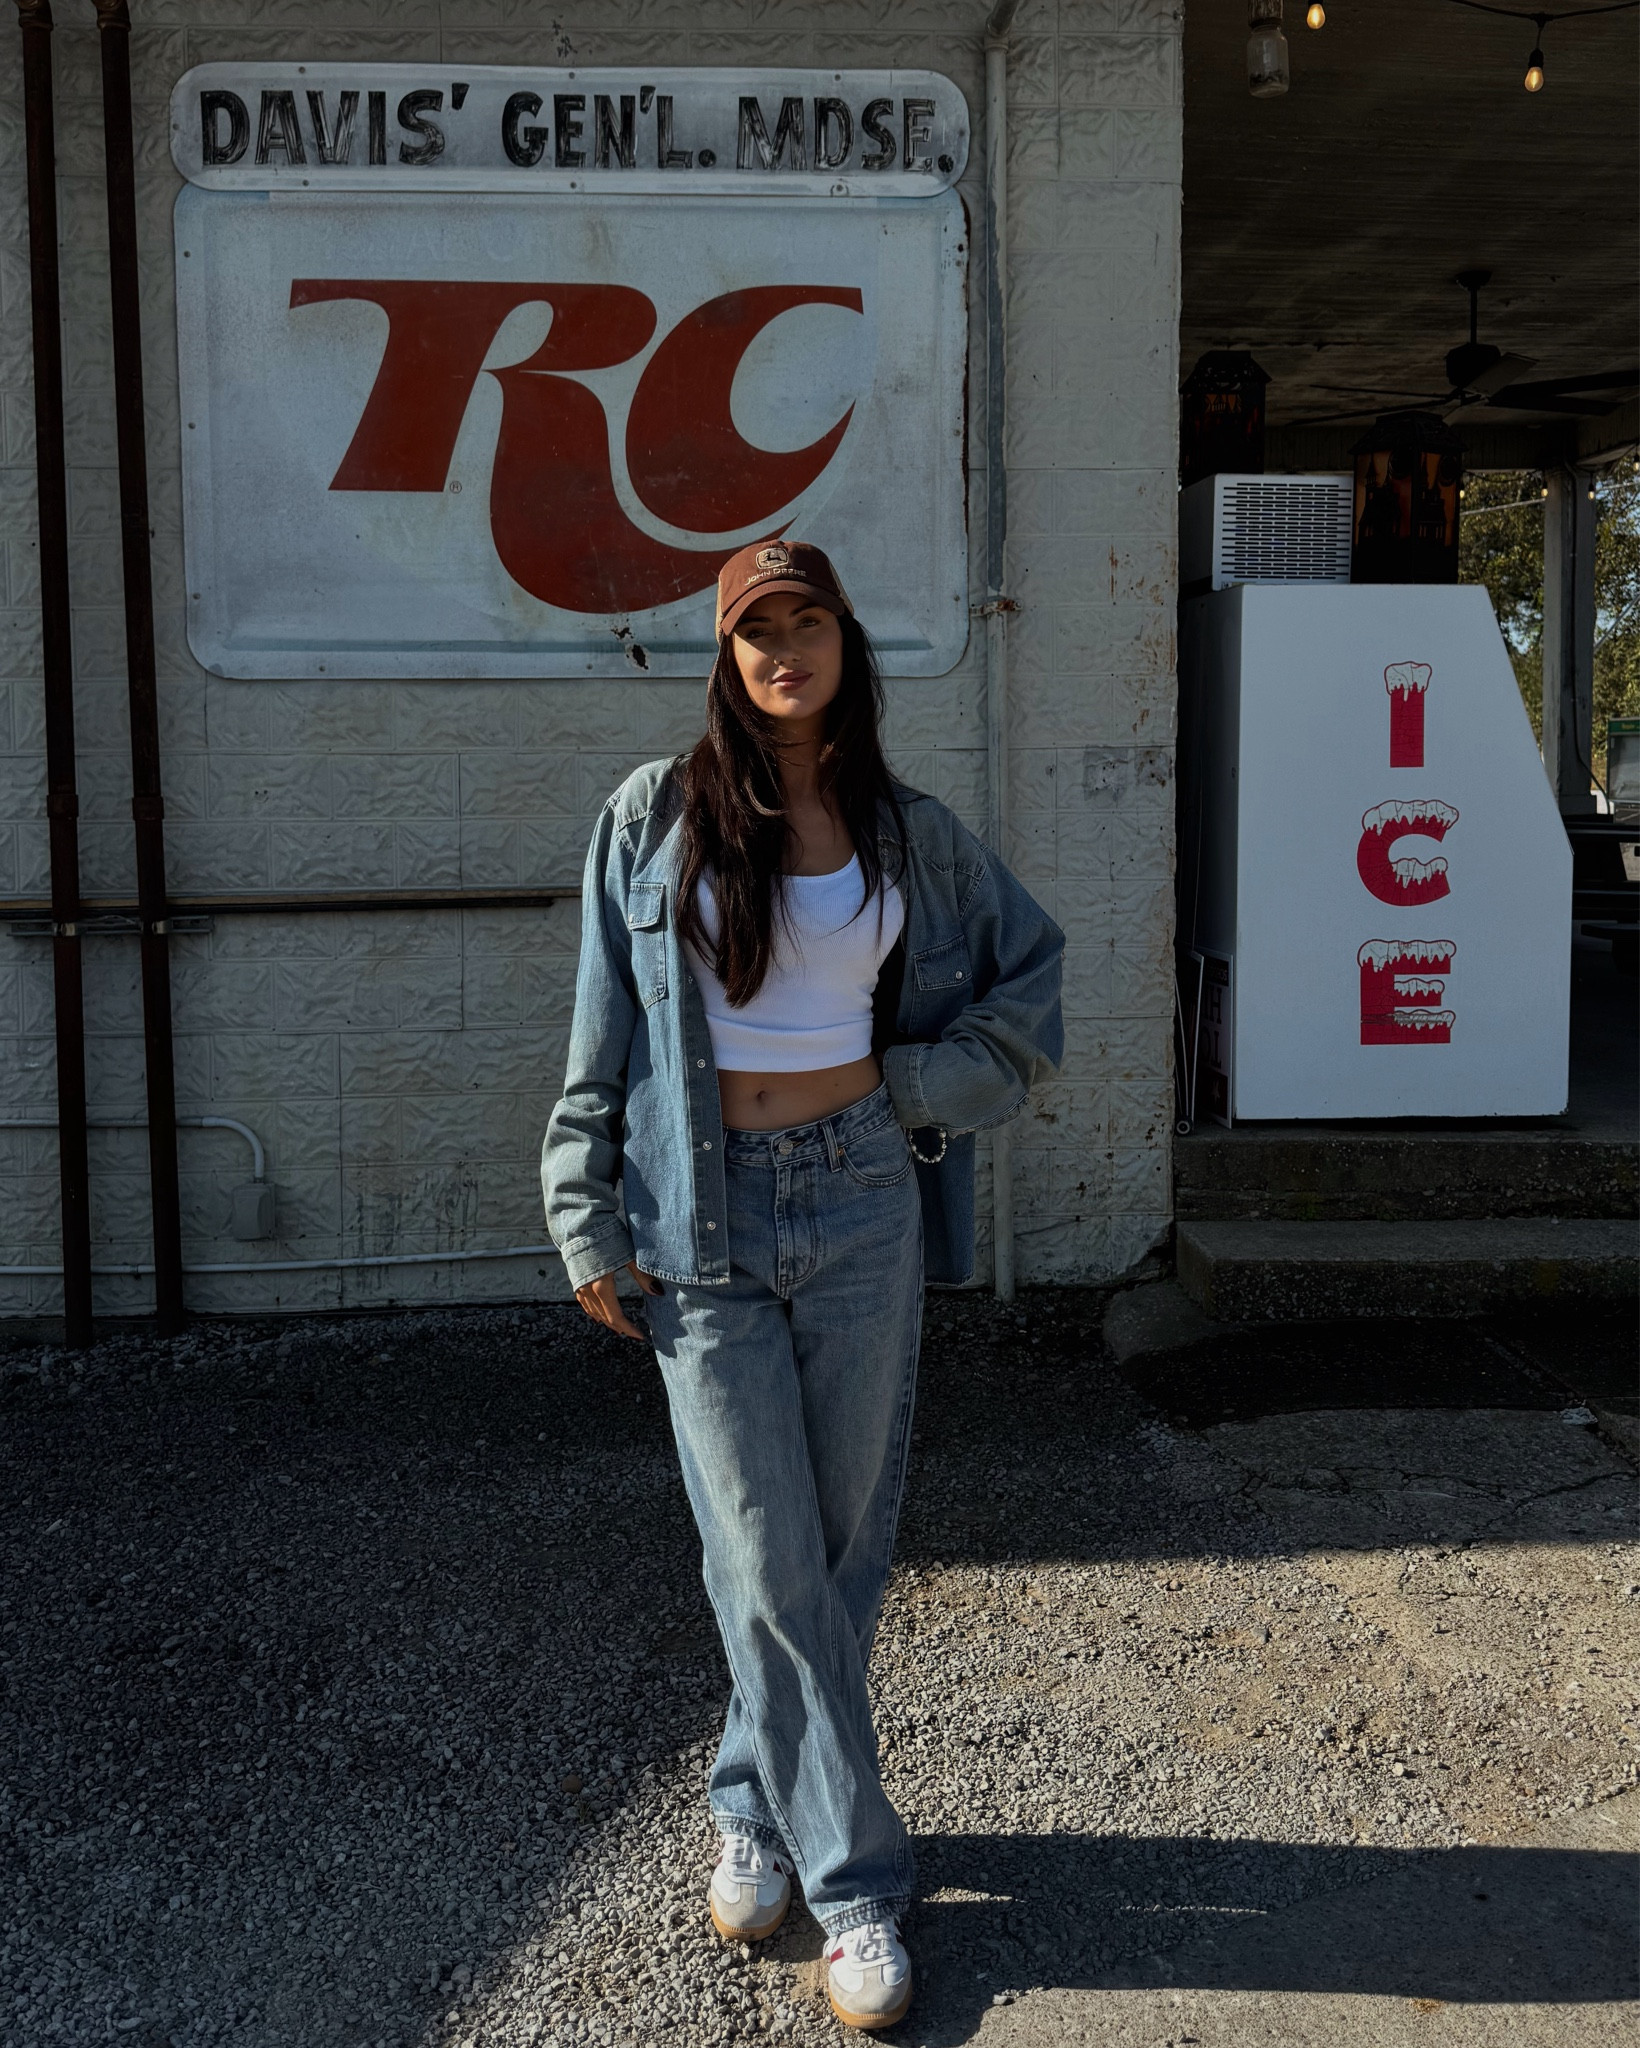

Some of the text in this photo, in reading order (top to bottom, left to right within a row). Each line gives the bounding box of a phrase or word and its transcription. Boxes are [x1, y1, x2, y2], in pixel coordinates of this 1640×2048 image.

[200, 83, 955, 174] DAVIS' GEN'L. MDSE.
[288, 278, 865, 615] RC
[744, 568, 807, 586] JOHN DEERE
[1356, 660, 1460, 1046] ICE
